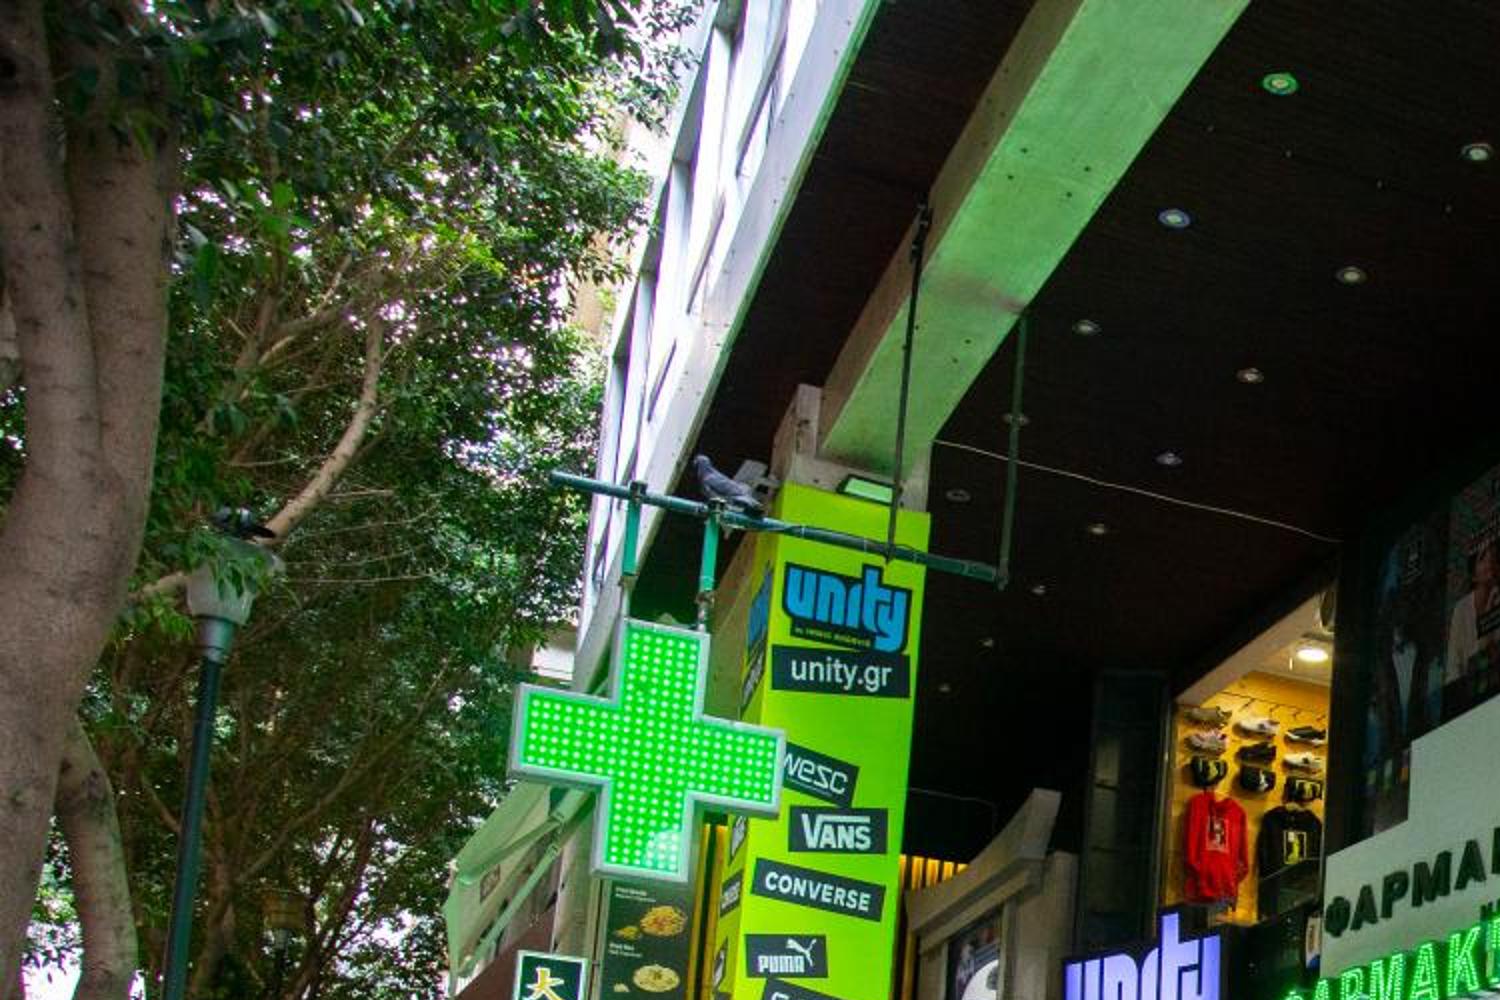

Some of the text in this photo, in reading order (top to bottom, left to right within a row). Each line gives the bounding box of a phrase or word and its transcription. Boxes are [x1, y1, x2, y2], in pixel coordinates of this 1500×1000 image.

[786, 567, 907, 653] unity
[791, 656, 892, 692] unity.gr
[801, 813, 871, 850] VANS
[765, 871, 871, 912] CONVERSE
[757, 955, 805, 973] PUMA
